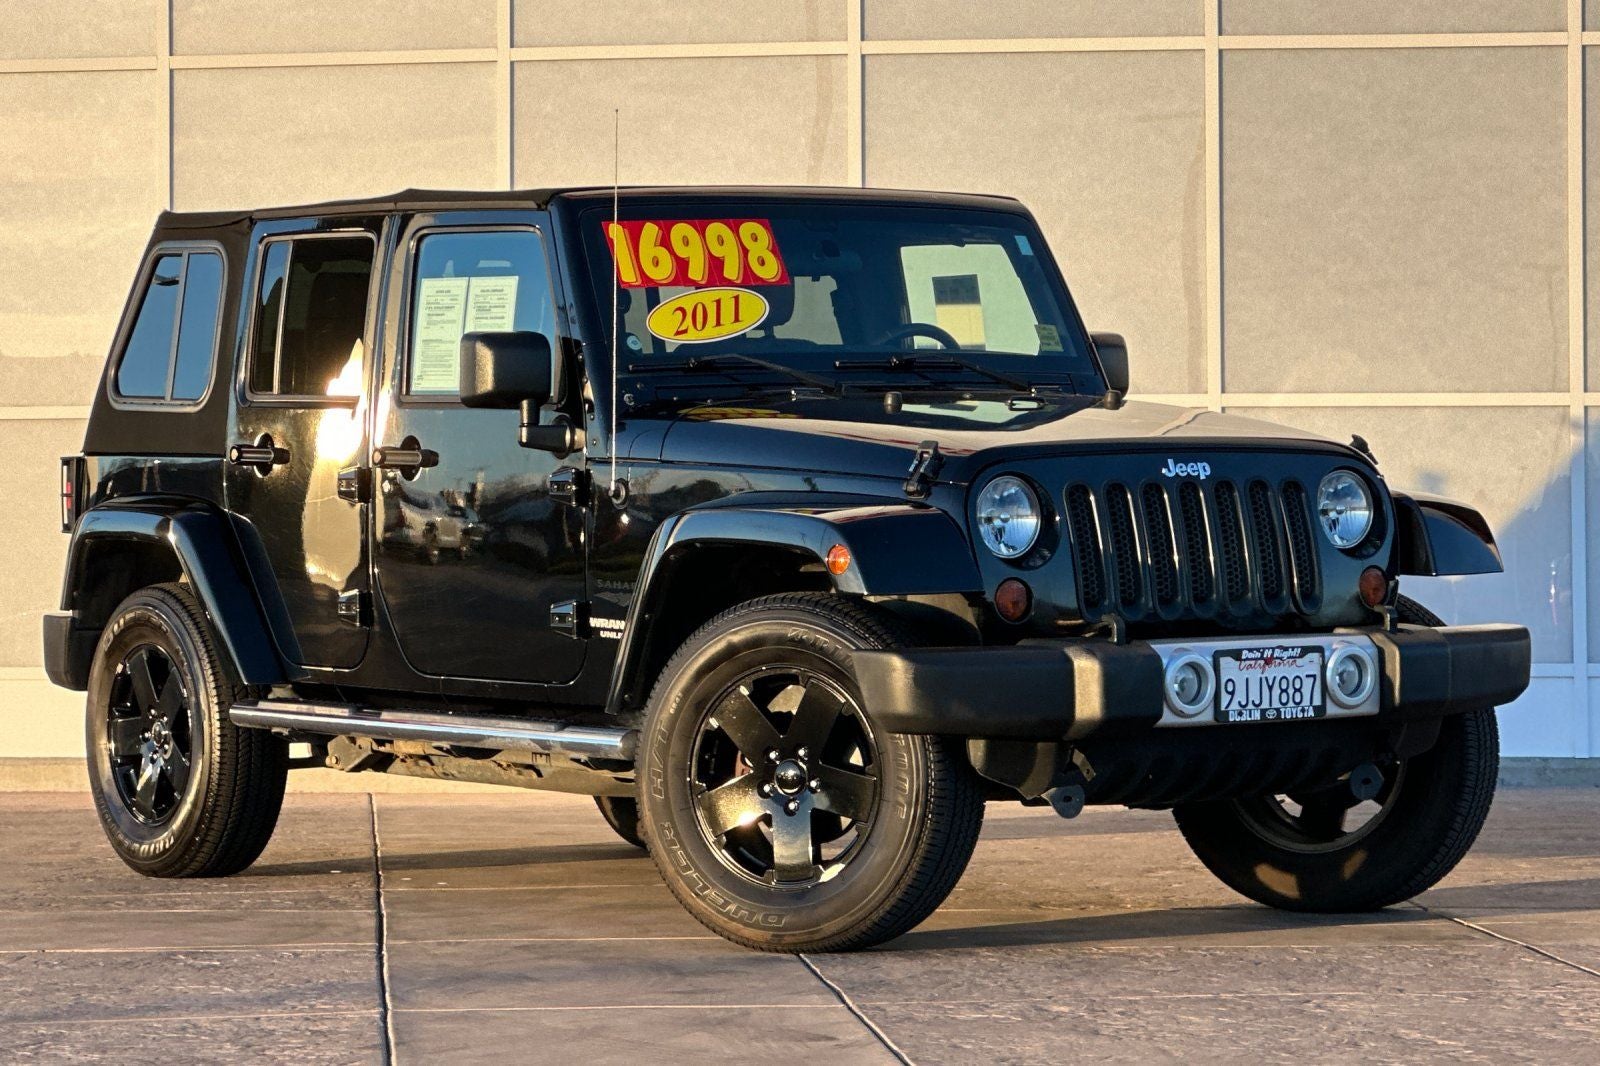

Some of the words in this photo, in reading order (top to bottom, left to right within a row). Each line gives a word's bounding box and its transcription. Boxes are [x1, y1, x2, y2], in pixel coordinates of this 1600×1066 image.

[608, 221, 782, 285] 16998
[672, 293, 744, 337] 2011
[1161, 458, 1211, 480] Jeep
[1224, 673, 1317, 710] 9JJY887
